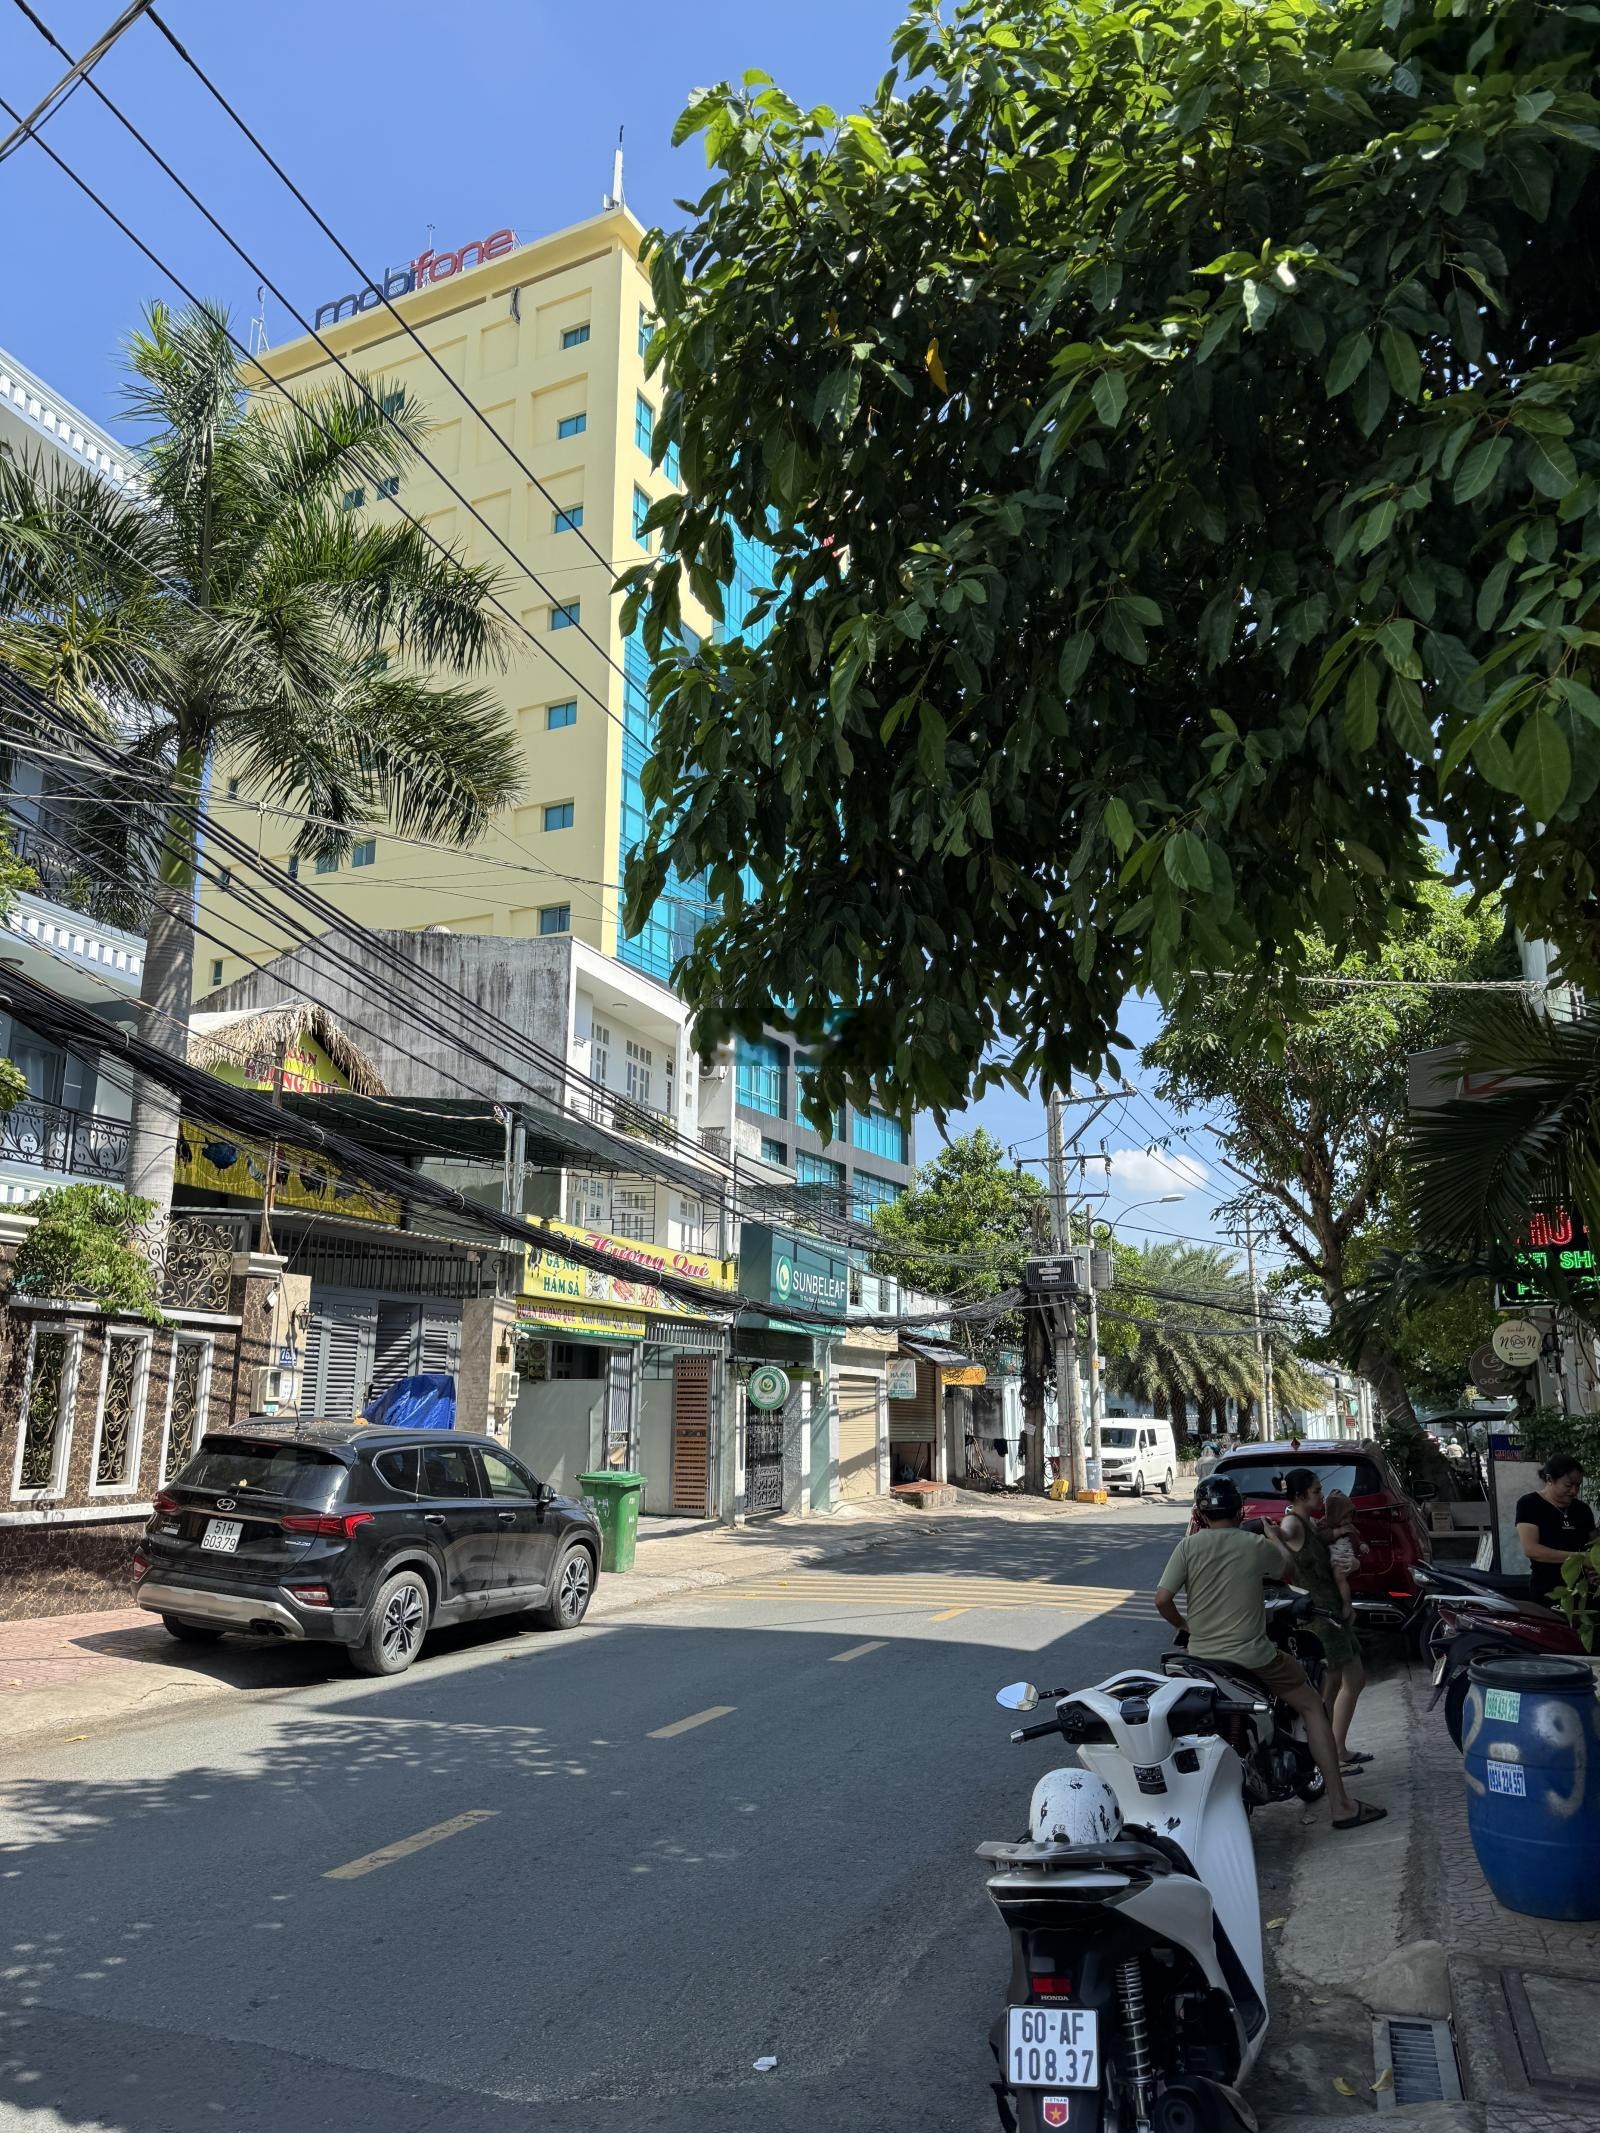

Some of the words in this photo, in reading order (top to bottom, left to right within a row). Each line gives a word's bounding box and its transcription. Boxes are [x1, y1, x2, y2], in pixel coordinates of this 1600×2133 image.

[314, 228, 514, 331] mobifone
[672, 1254, 710, 1278] Quê
[792, 1270, 846, 1299] SUNBELEAF
[203, 1535, 237, 1551] 603.79
[214, 1521, 235, 1536] 51H
[1021, 2010, 1084, 2045] 60-AF
[1014, 2046, 1094, 2084] 108.37
